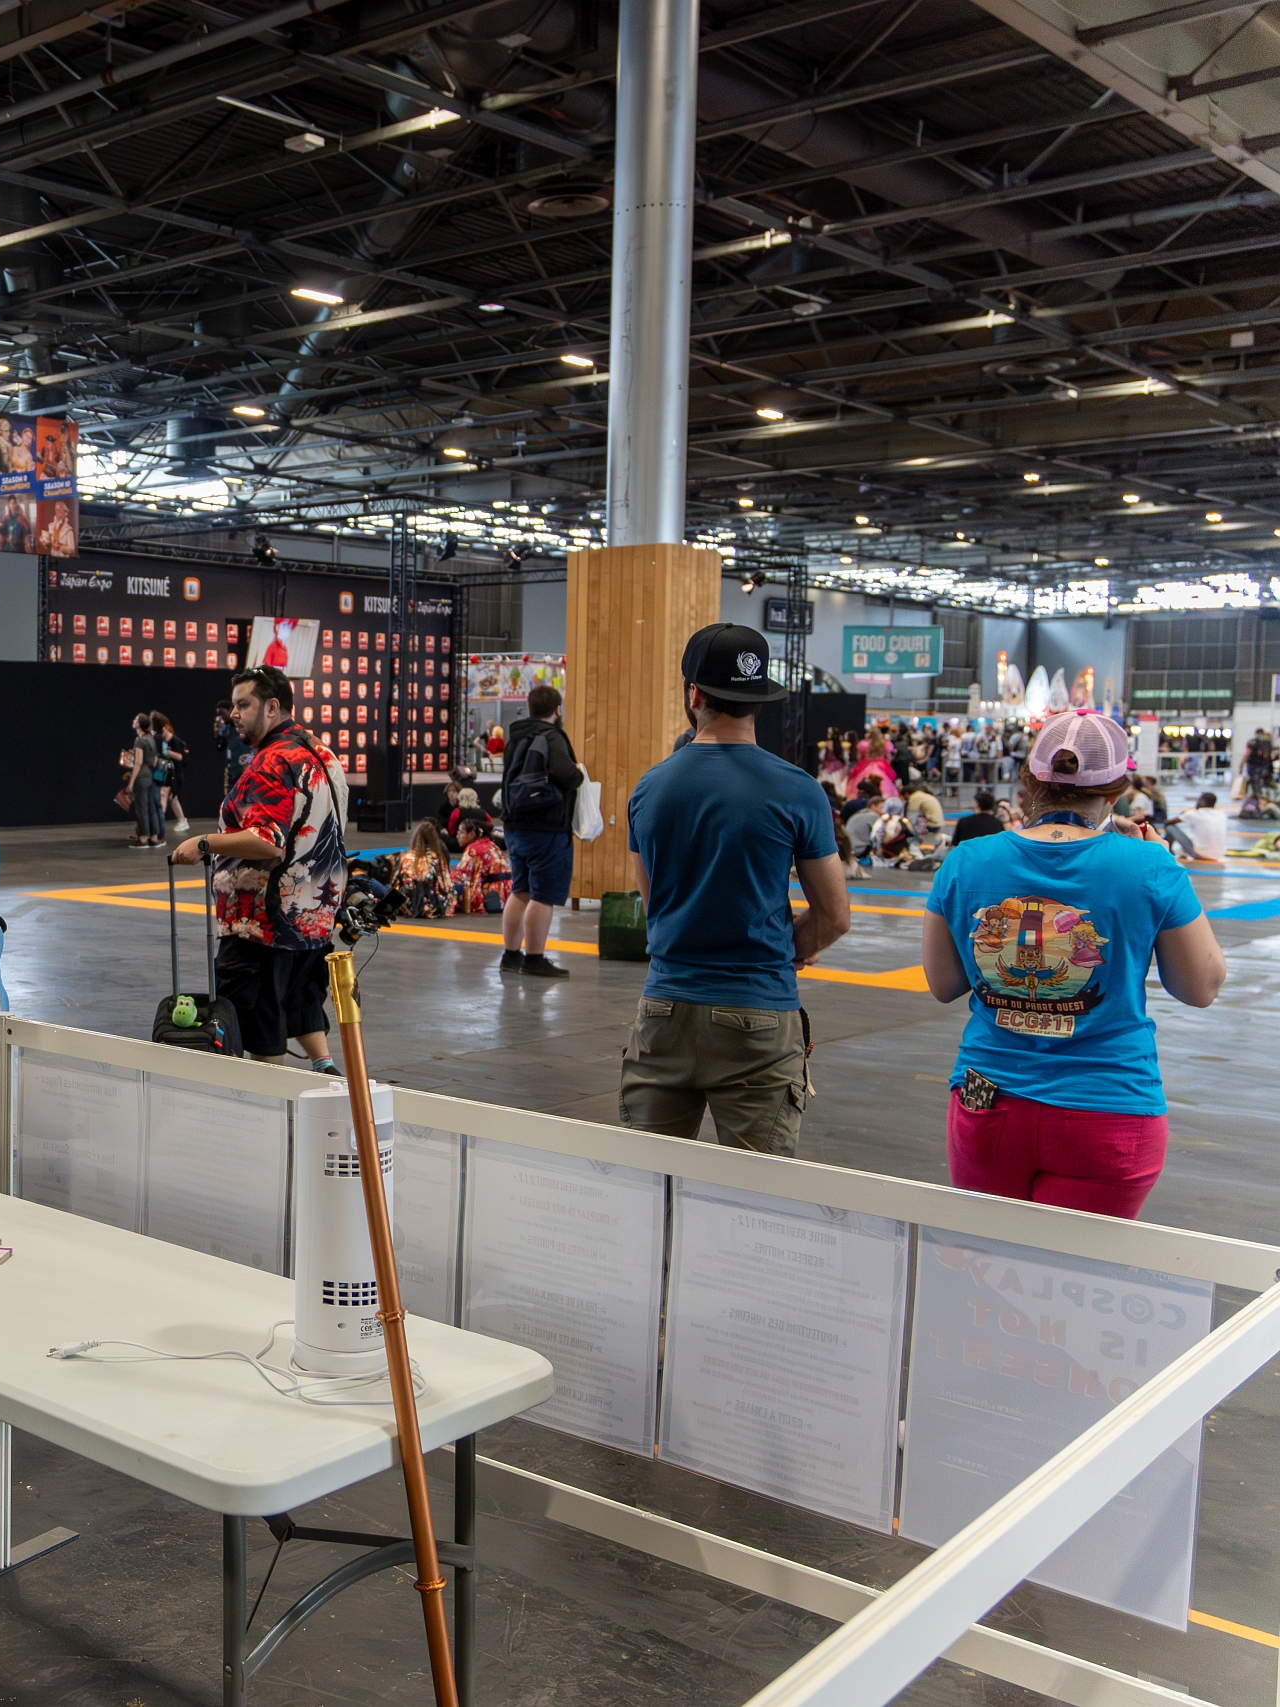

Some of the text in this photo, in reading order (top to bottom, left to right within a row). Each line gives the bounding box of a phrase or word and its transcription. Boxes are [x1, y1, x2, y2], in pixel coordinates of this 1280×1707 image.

[1, 475, 22, 485] SEASON
[43, 481, 64, 490] SEASON
[0, 482, 31, 492] CHAMPIONS
[42, 487, 73, 497] CHAMPIONS
[60, 573, 113, 592] Japan Expo
[127, 575, 170, 597] KITSUNÉ
[852, 635, 933, 652] FOOD COURT
[987, 996, 1008, 1006] TEAM
[1011, 1001, 1022, 1009] DU
[997, 1009, 1074, 1032] ECG#11
